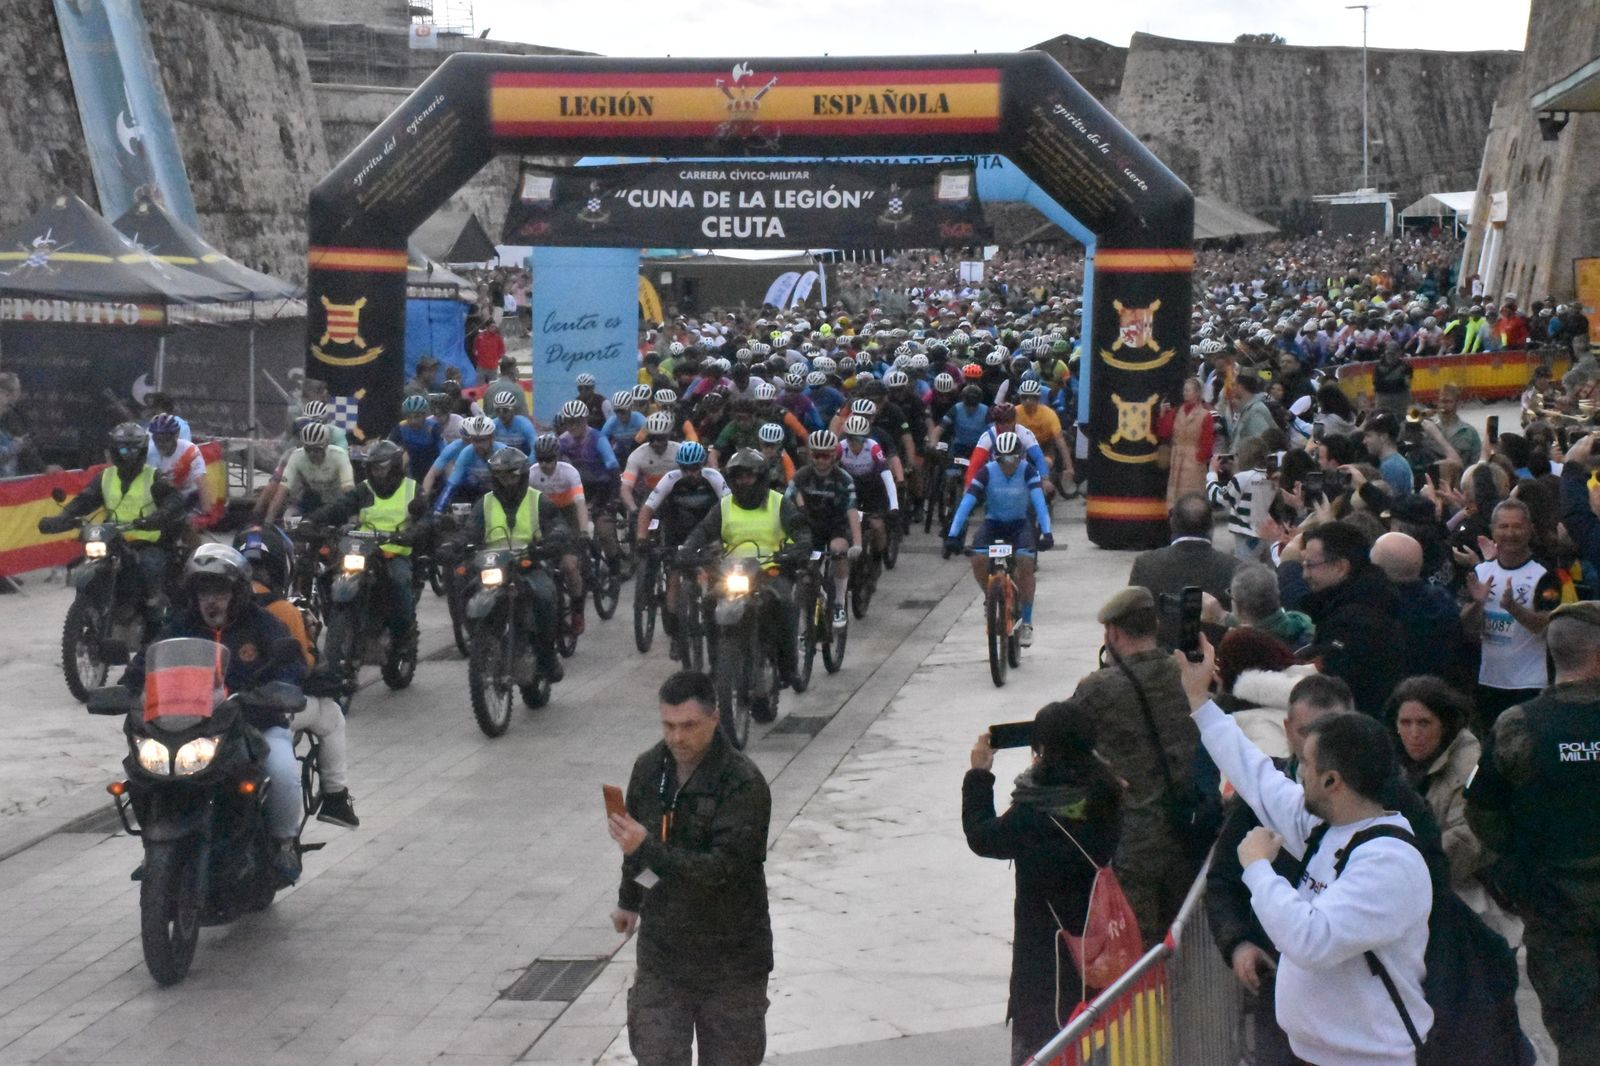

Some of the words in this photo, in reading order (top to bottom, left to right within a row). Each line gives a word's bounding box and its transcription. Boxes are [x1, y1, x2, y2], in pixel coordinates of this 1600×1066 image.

[559, 90, 654, 117] LEGIÓN
[812, 88, 950, 115] ESPAÑOLA
[679, 170, 727, 180] CARRERA
[729, 168, 810, 180] CÍVICO-MILITAR
[702, 190, 731, 209] DE
[738, 190, 767, 209] LA
[701, 215, 786, 238] CEUTA
[604, 315, 622, 330] es
[545, 342, 625, 372] Deporte
